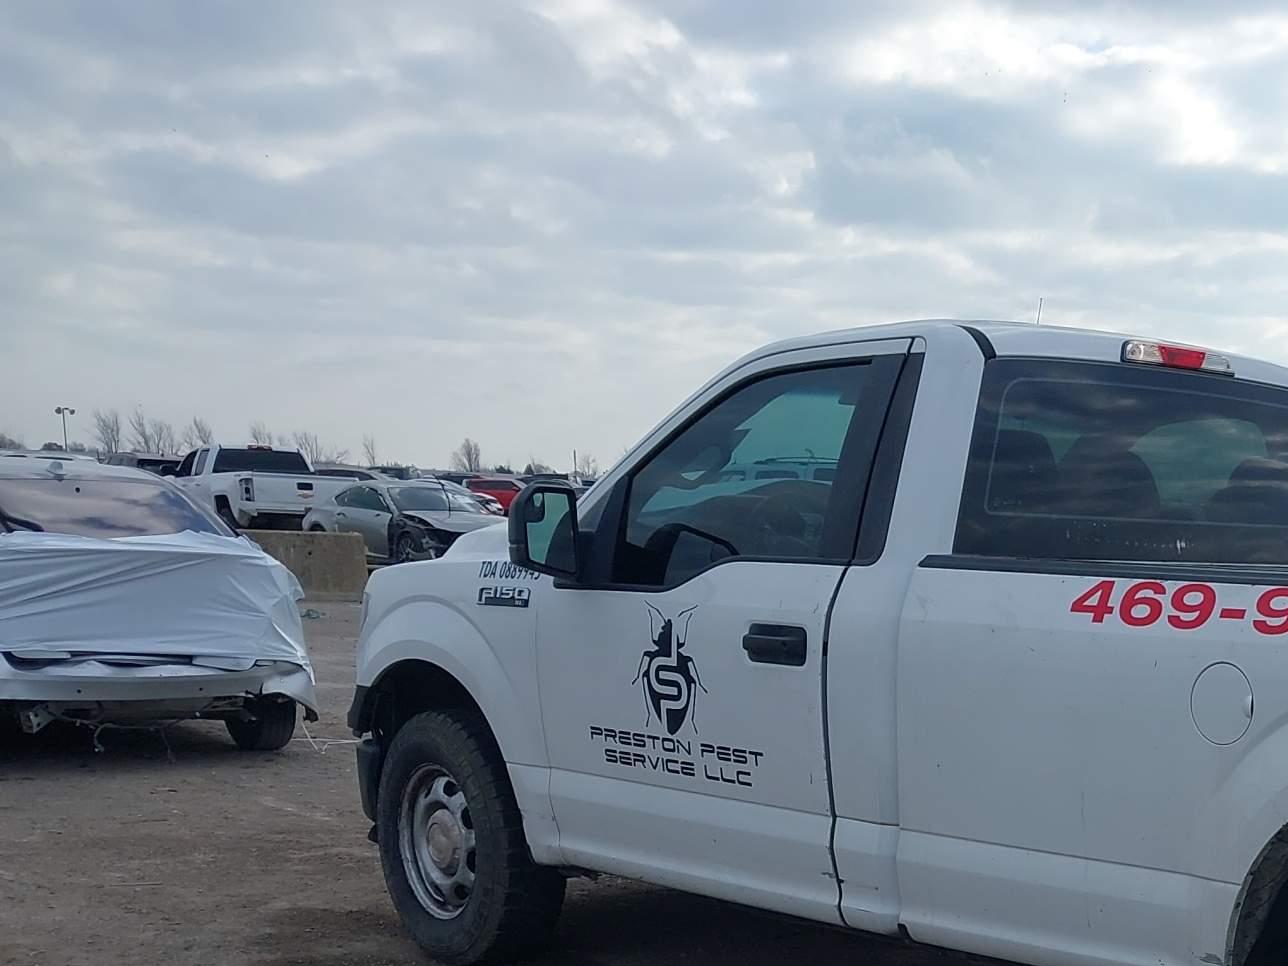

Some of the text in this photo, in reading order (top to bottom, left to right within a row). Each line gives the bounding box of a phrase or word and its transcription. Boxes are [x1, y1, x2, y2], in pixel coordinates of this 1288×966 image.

[479, 560, 498, 578] TDA
[589, 725, 764, 767] PRESTON PEST
[604, 748, 753, 787] SERVICE LLC
